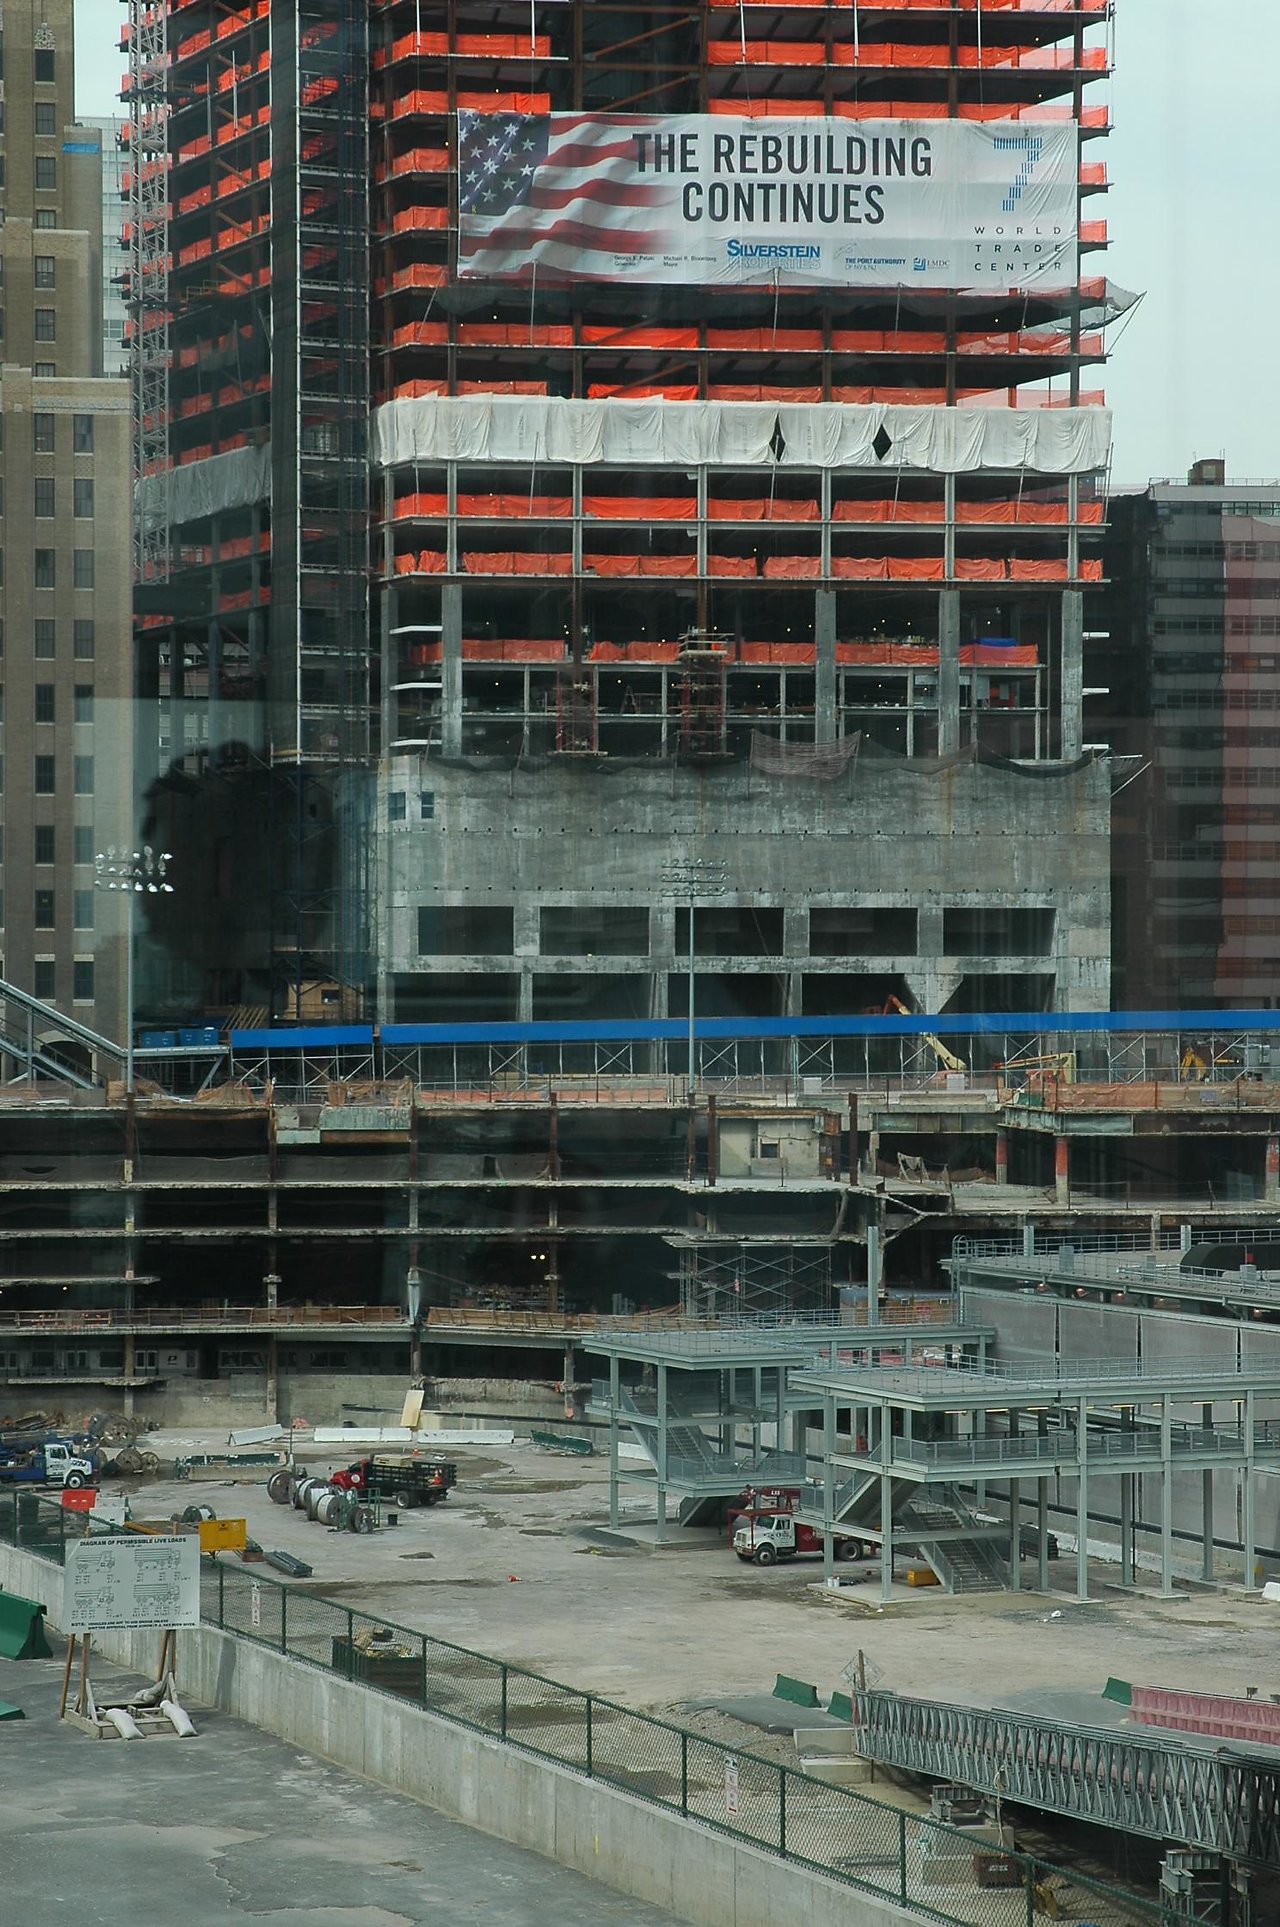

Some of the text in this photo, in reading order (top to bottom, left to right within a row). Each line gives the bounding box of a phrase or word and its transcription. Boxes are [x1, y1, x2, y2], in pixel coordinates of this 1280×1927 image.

[632, 133, 932, 176] THE REBUILDING
[682, 181, 885, 224] CONTINUES
[974, 226, 1061, 235] WORLD
[727, 239, 820, 258] SILVERSTEIN
[975, 244, 1062, 253] TRADE
[728, 256, 821, 269] PROPERTIES
[974, 262, 1062, 272] CENTER
